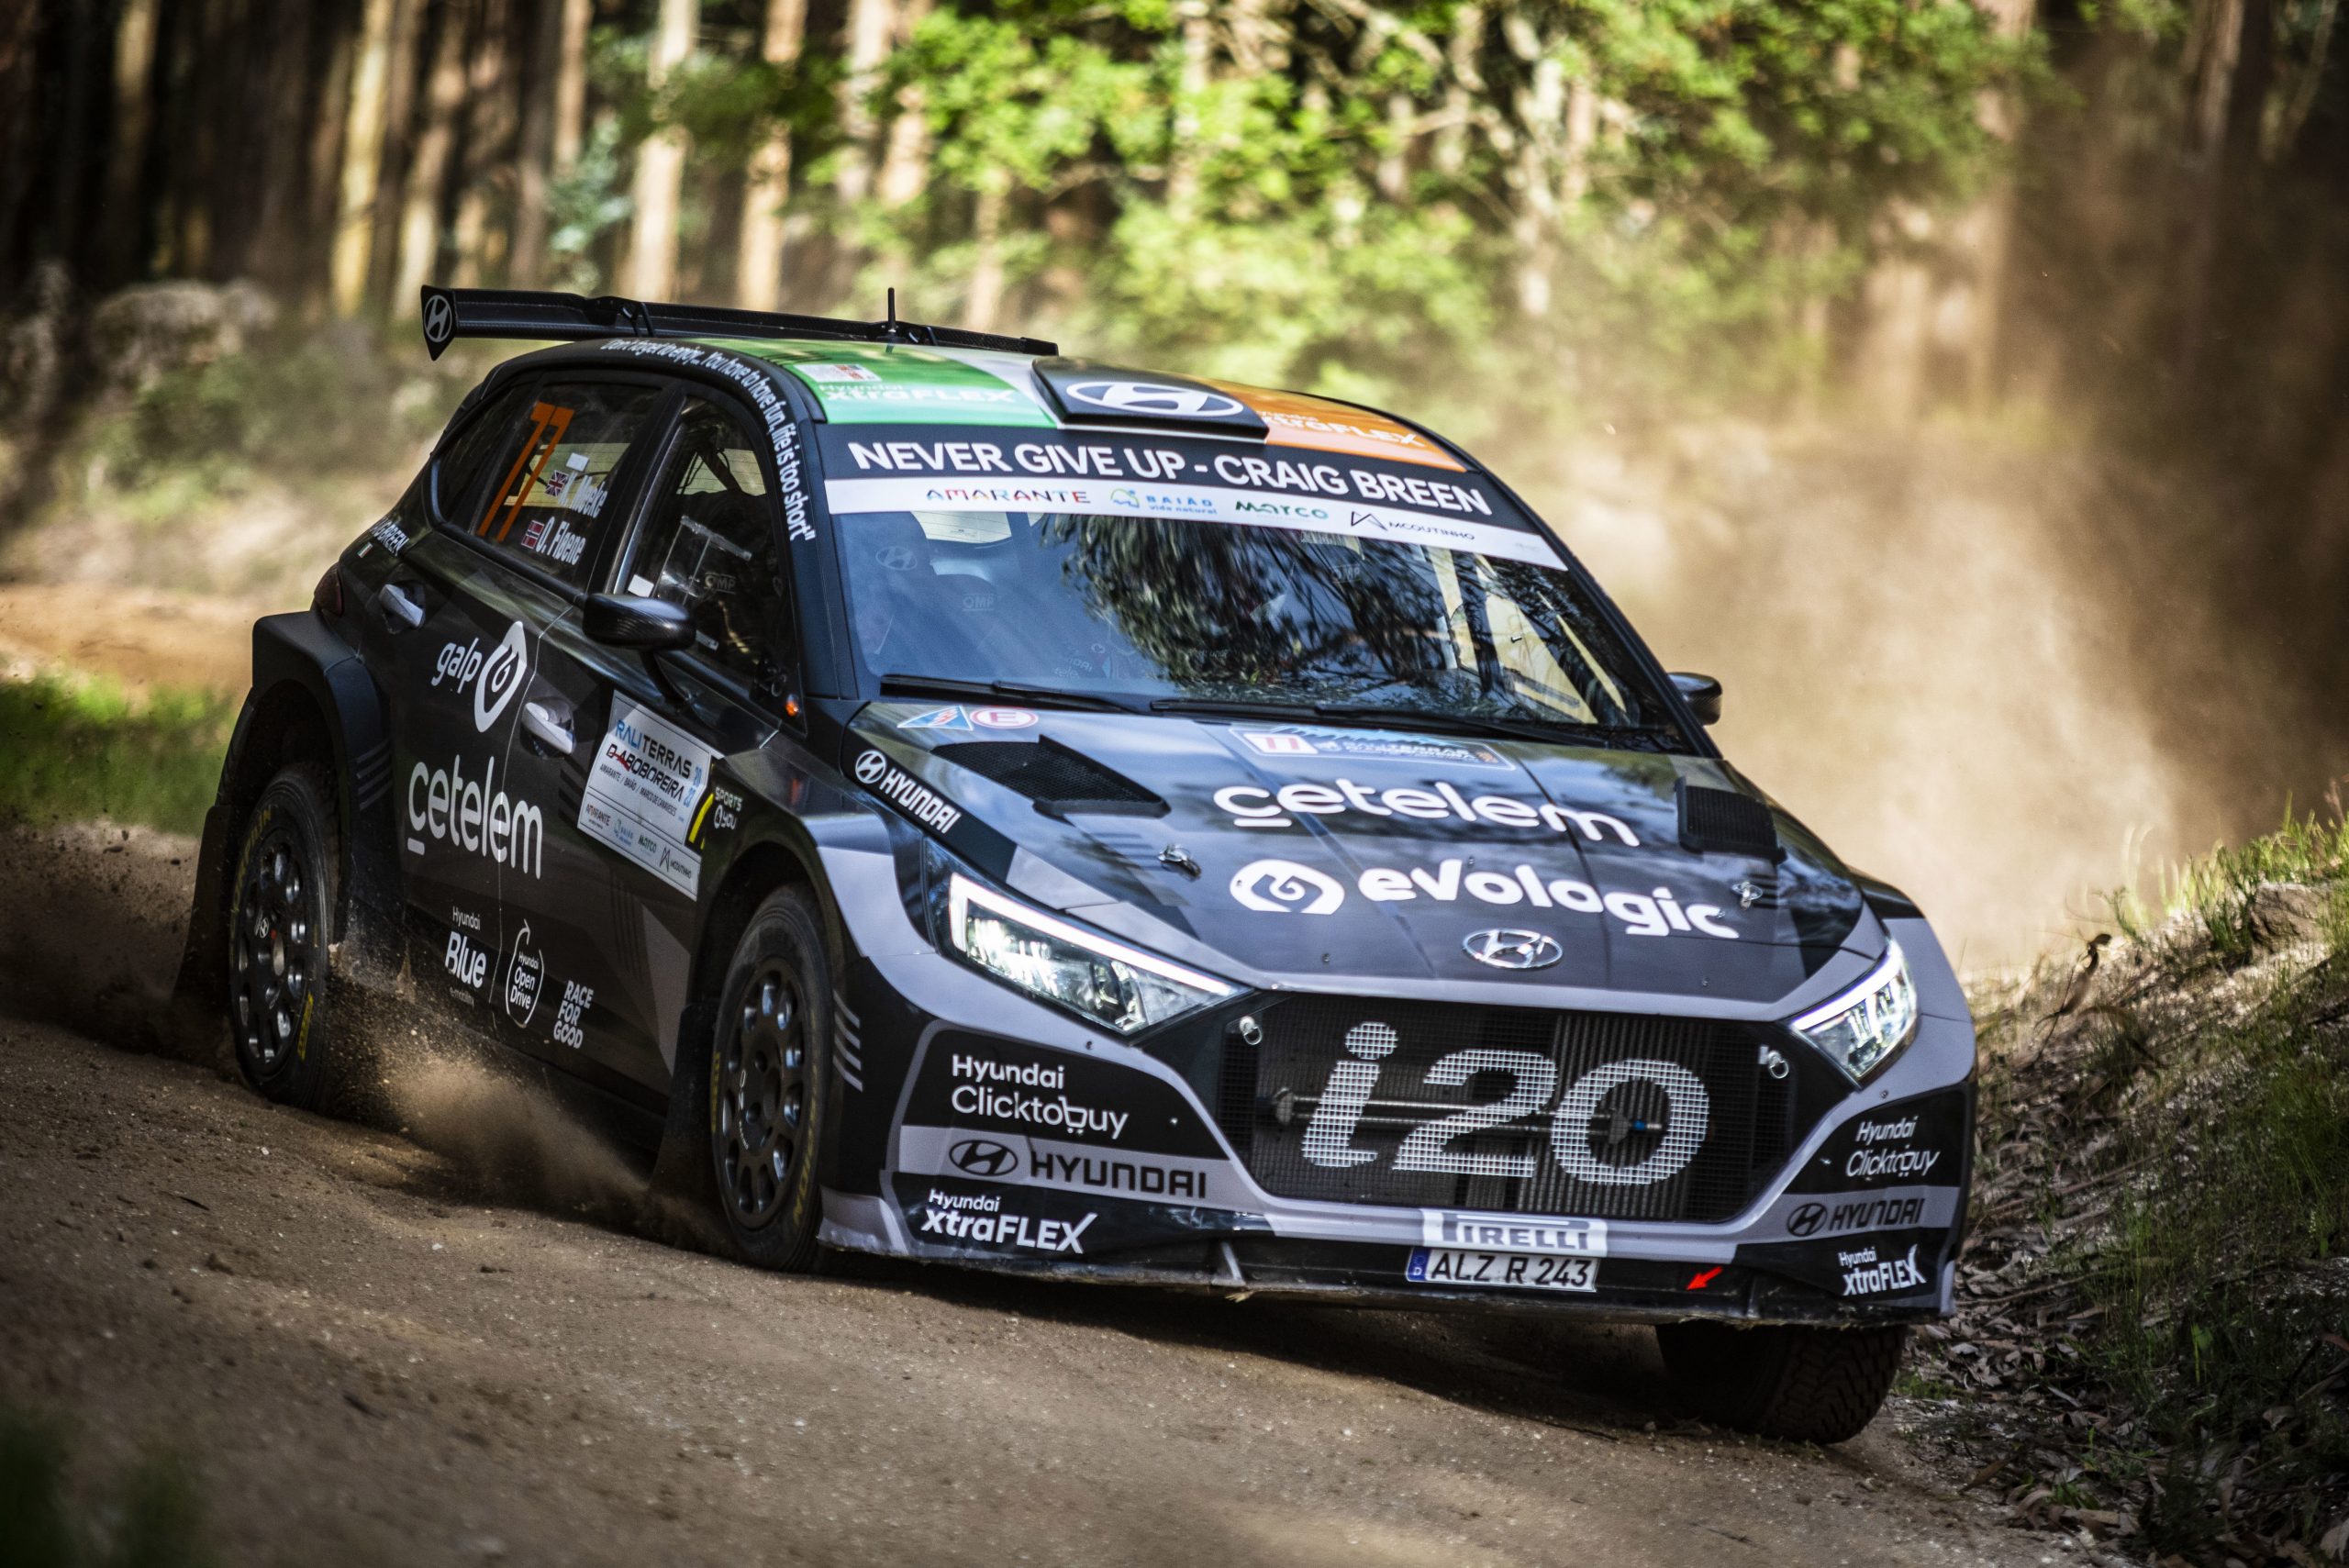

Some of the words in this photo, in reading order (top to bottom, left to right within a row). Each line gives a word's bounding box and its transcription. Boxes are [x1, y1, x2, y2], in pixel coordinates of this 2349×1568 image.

[741, 371, 760, 387] to
[749, 377, 776, 408] have
[776, 444, 800, 465] is
[477, 401, 574, 543] 77
[779, 461, 800, 493] too
[848, 442, 1013, 472] NEVER
[1014, 444, 1123, 476] GIVE
[1123, 448, 1186, 480] UP
[1214, 454, 1350, 495] CRAIG
[1350, 469, 1492, 516] BREEN
[927, 489, 1091, 504] AMARANTE
[1175, 506, 1218, 516] natural
[430, 637, 483, 694] galp
[715, 786, 742, 812] SPORTS
[879, 768, 962, 834] HYUNDAI
[1213, 779, 1640, 846] cetelem
[407, 754, 542, 880] cetelem
[452, 906, 481, 930] Hyundai
[445, 930, 486, 988] Blue
[518, 951, 539, 970] Hyundai
[515, 966, 536, 991] Open
[510, 985, 531, 1009] Drive
[563, 980, 594, 1009] RACE
[558, 1000, 581, 1026] FOR
[553, 1020, 584, 1049] GOOD
[952, 1054, 1064, 1089] Hyundai
[1300, 1021, 1709, 1185] i20
[1856, 1116, 1919, 1145] Hyundai
[1031, 1151, 1207, 1199] HYUNDAI
[929, 1188, 1001, 1213] Hyundai
[1829, 1198, 1925, 1230] HYUNDAI
[921, 1208, 1097, 1254] xtraFLEX
[1442, 1213, 1590, 1250] PIRELLI
[1413, 1267, 1421, 1276] D
[1431, 1253, 1497, 1281] ALZ
[1505, 1257, 1530, 1284] R
[1535, 1258, 1592, 1287] 243
[1838, 1247, 1876, 1267] Hyundai
[1843, 1244, 1926, 1296] xtraFLEX
